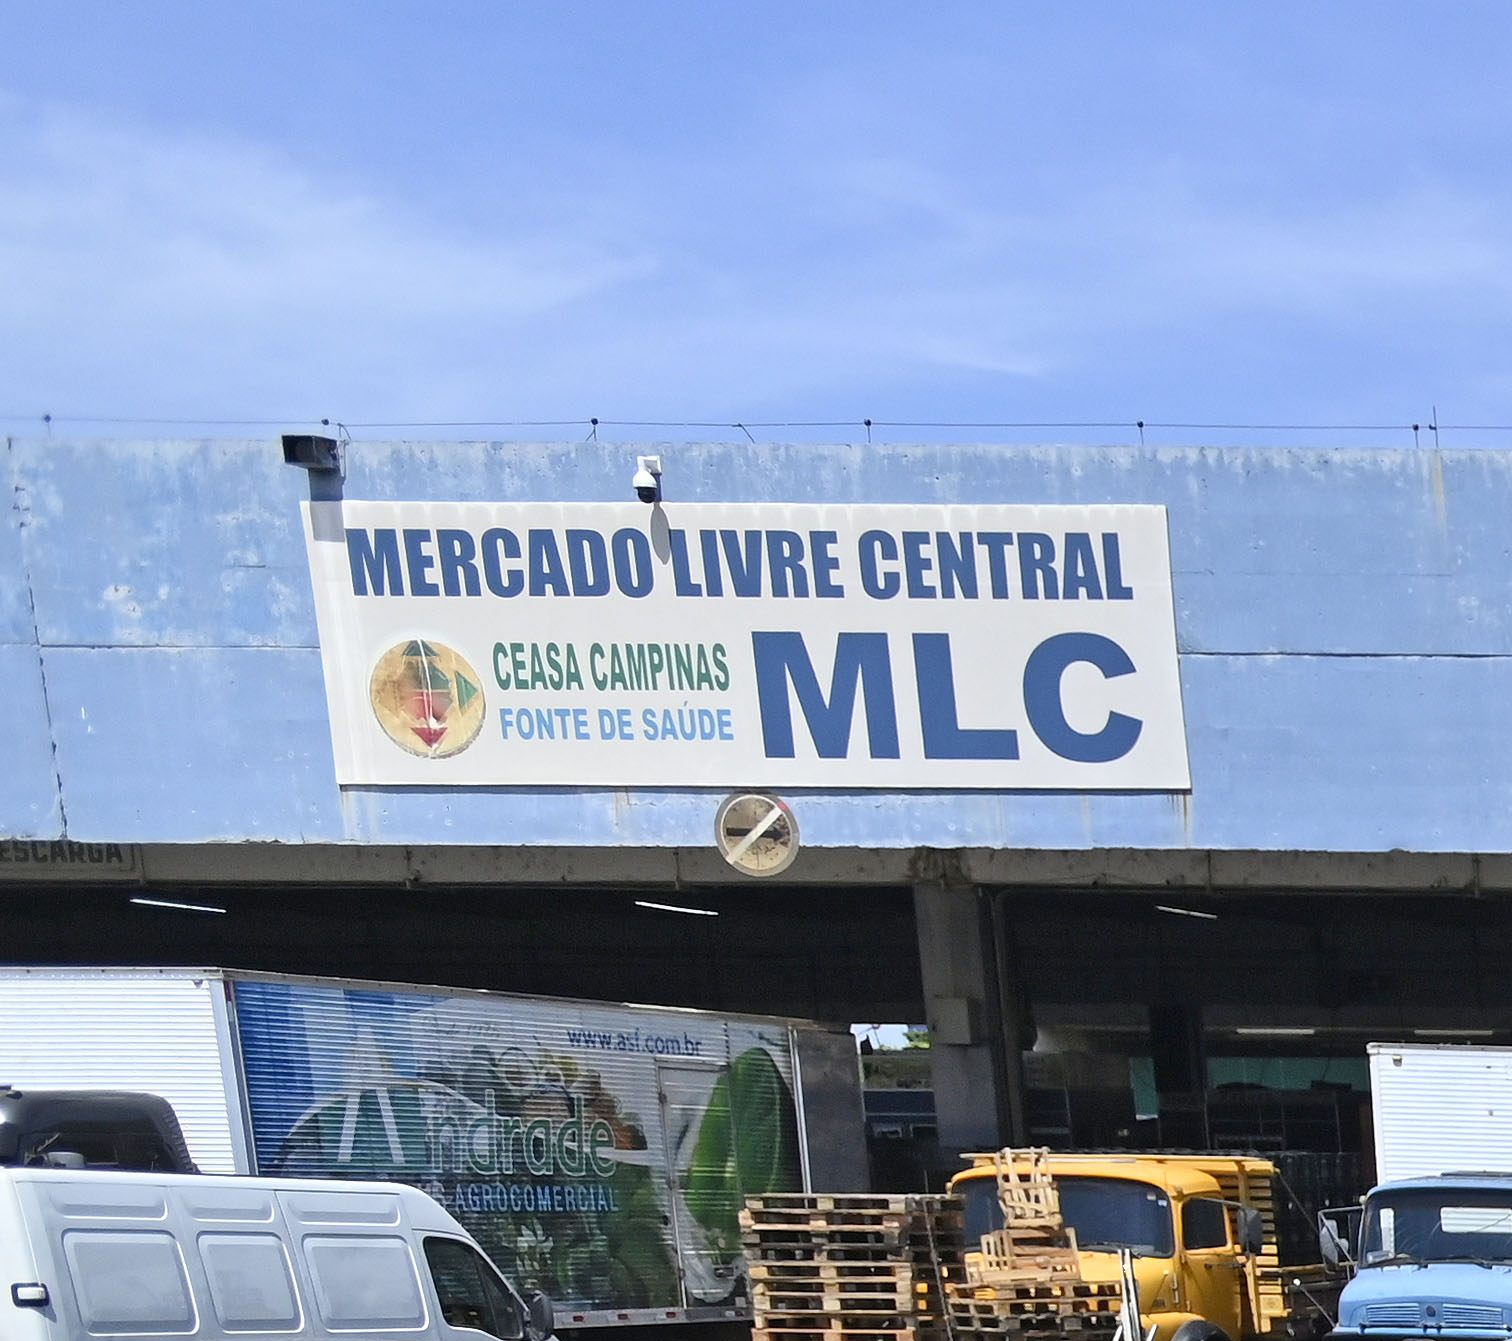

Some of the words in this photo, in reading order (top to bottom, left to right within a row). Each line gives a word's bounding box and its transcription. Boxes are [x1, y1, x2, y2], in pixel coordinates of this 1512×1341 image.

[346, 527, 654, 599] MERCADO
[668, 528, 843, 599] LIVRE
[859, 530, 1133, 600] CENTRAL
[493, 641, 582, 691] CEASA
[591, 642, 730, 692] CAMPINAS
[500, 707, 588, 741] FONTE
[601, 708, 636, 741] DE
[642, 699, 734, 741] SAÚDE
[751, 630, 1143, 764] MLC
[454, 1183, 619, 1212] AGROCOMERCIAL
